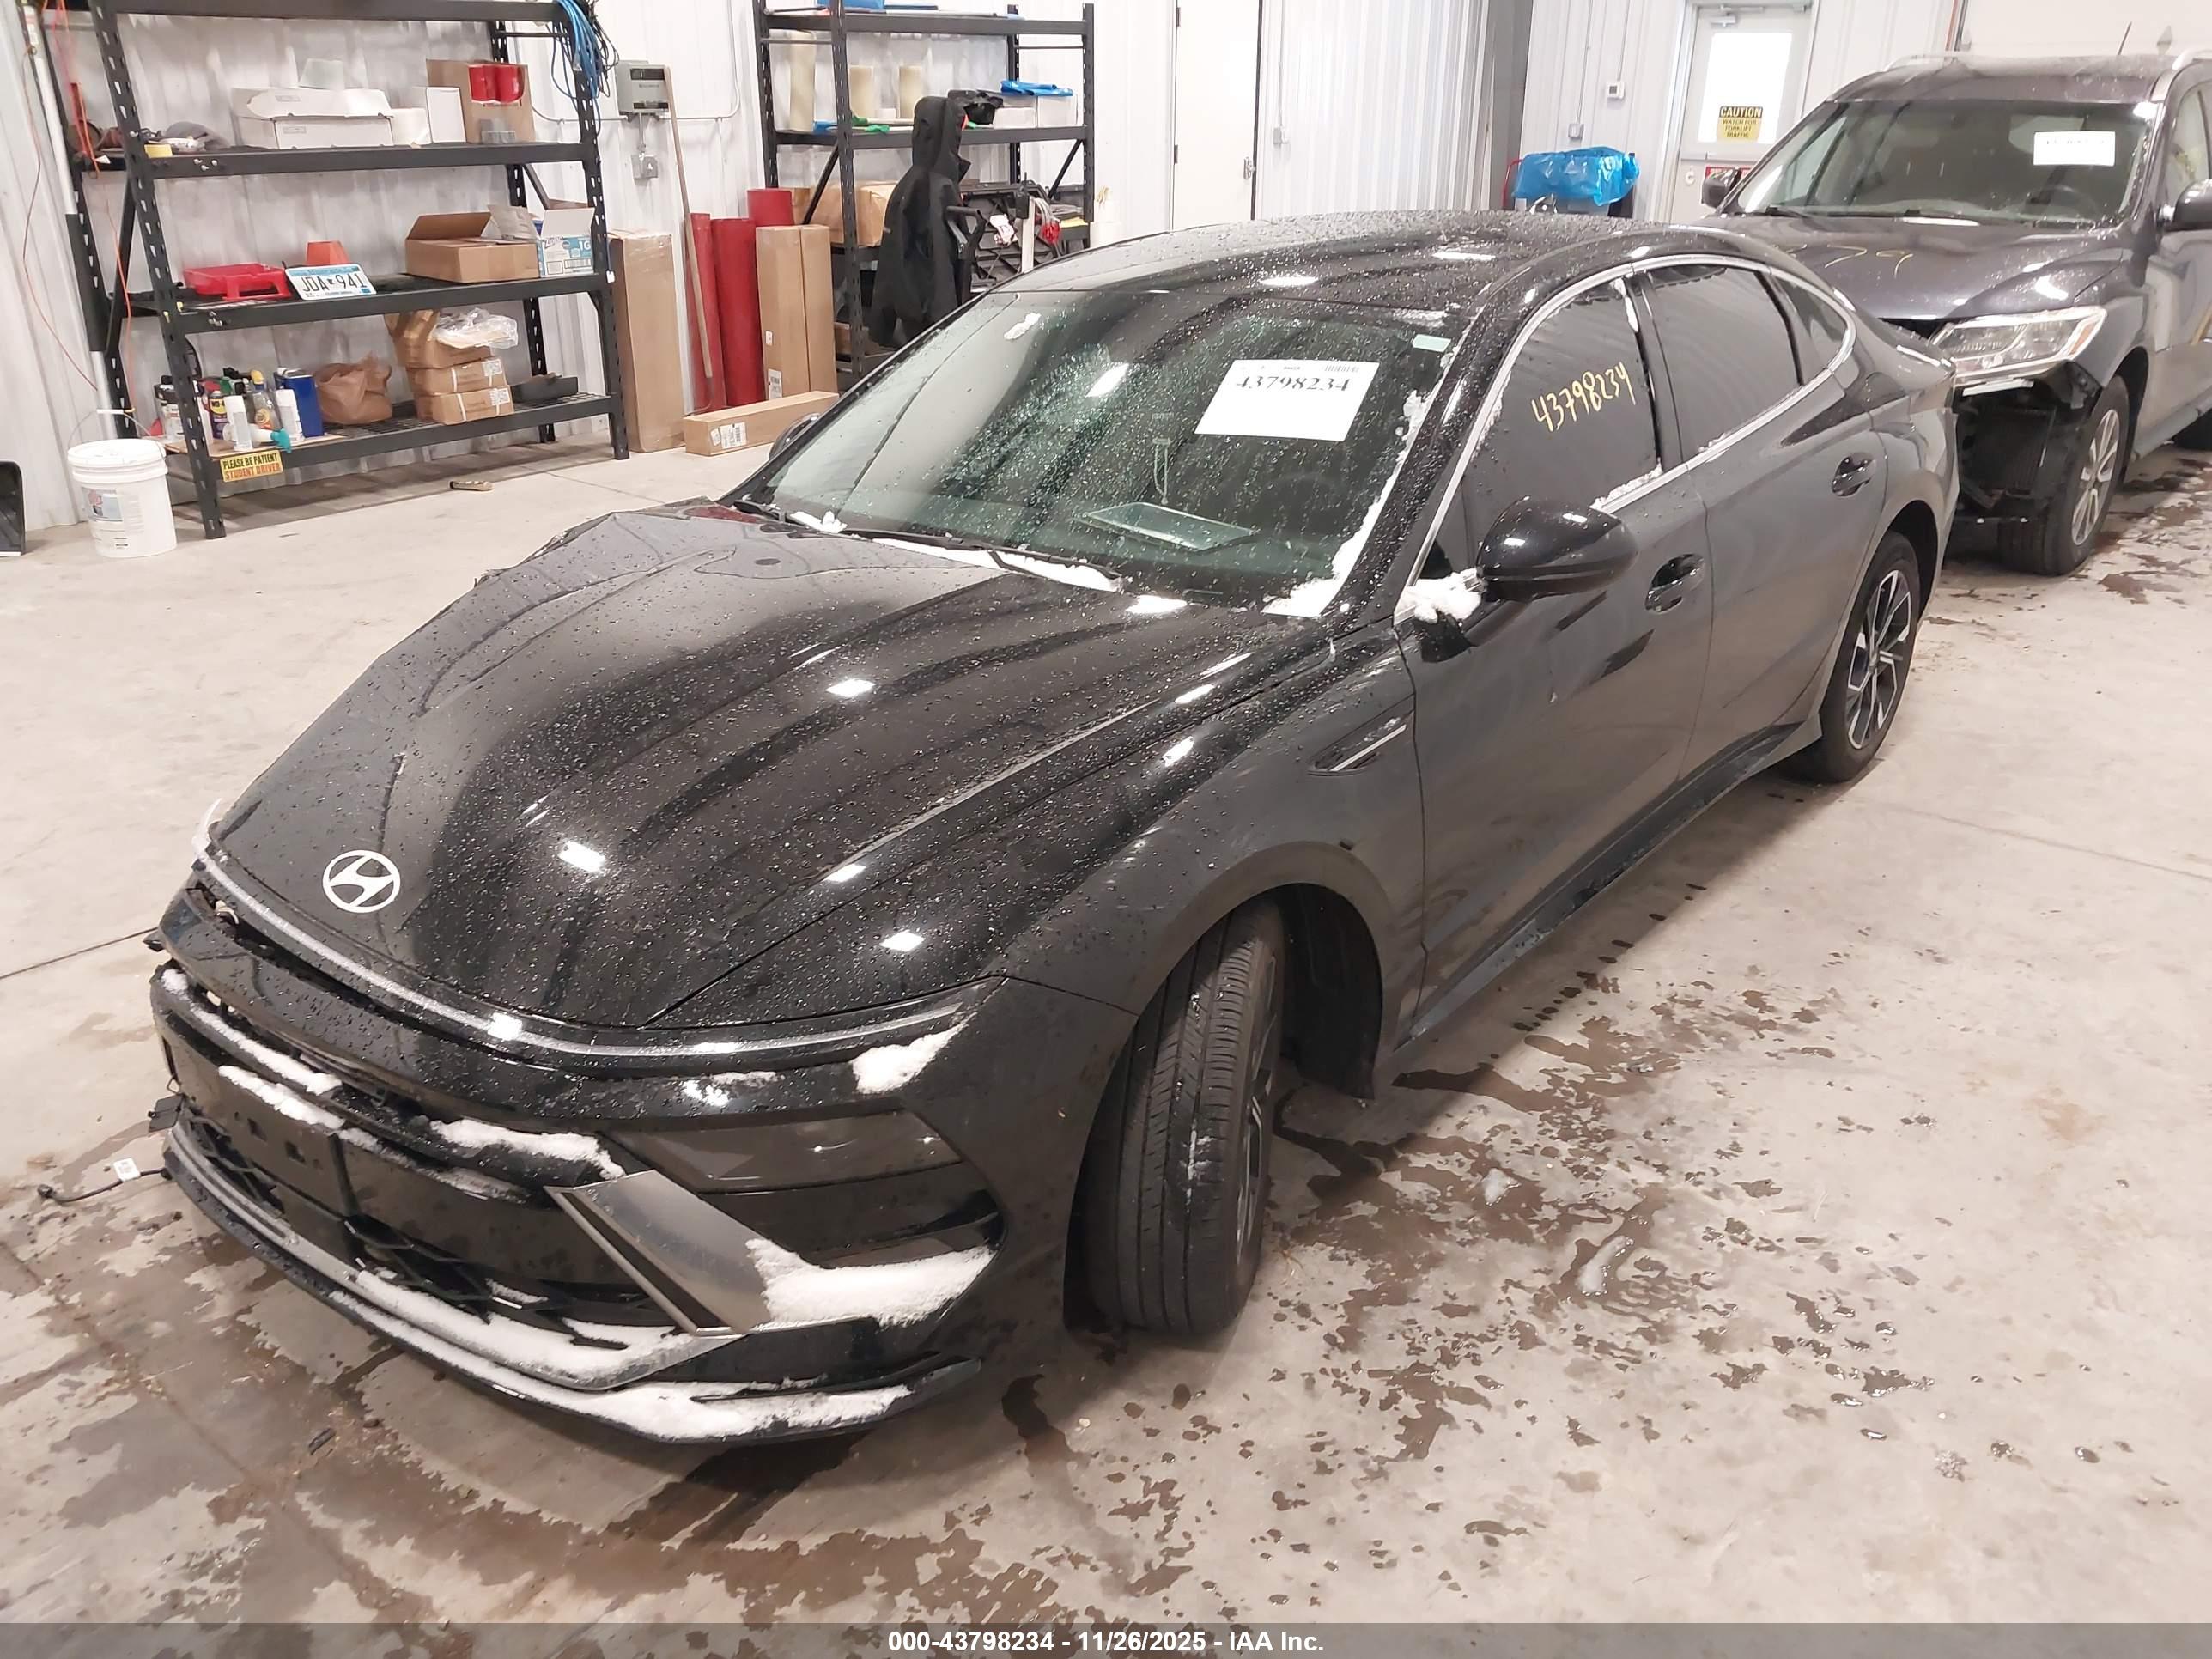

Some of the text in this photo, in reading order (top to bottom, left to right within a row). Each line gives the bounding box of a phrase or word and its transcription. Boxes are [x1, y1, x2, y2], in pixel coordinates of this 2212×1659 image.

[1720, 107, 1762, 118] CAUTION
[1236, 374, 1351, 392] 43798234
[1531, 361, 1637, 432] 43798234
[223, 453, 277, 469] PLEASE BE PATIENT
[225, 462, 280, 479] STUDENT DRIVER
